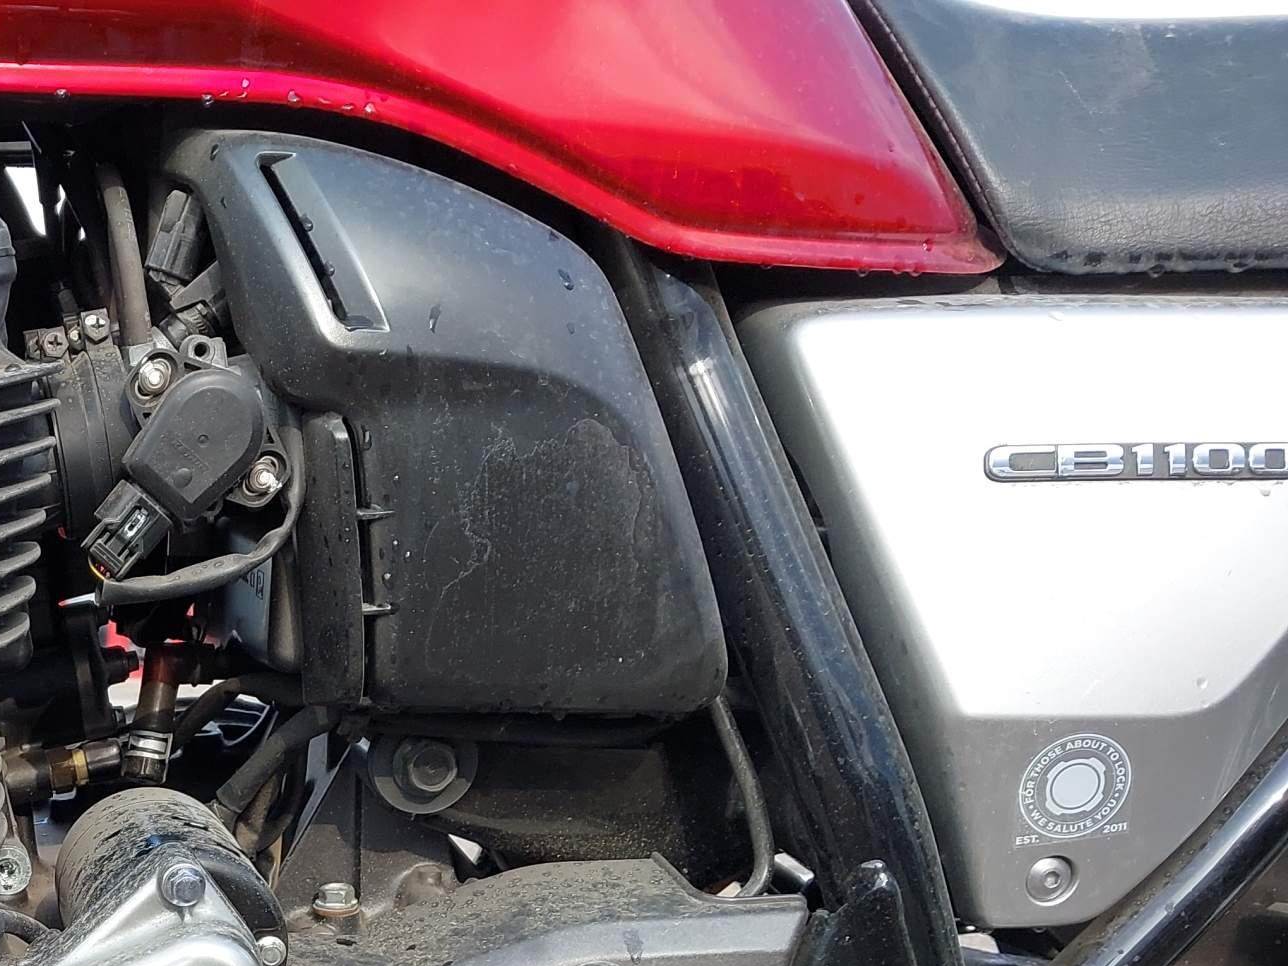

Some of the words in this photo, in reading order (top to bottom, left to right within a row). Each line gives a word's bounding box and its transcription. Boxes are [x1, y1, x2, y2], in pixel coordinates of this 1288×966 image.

[988, 442, 1288, 478] CB1100
[1023, 781, 1035, 805] FOR
[1030, 746, 1065, 777] THOSE
[1065, 739, 1108, 751] ABOUT
[1106, 747, 1120, 761] TO
[1114, 761, 1126, 791] LOCK
[1015, 834, 1040, 845] EST.
[1102, 822, 1128, 834] 2011
[1031, 809, 1048, 826] WE
[1046, 818, 1094, 833] SALUTE
[1094, 799, 1117, 820] YOU
